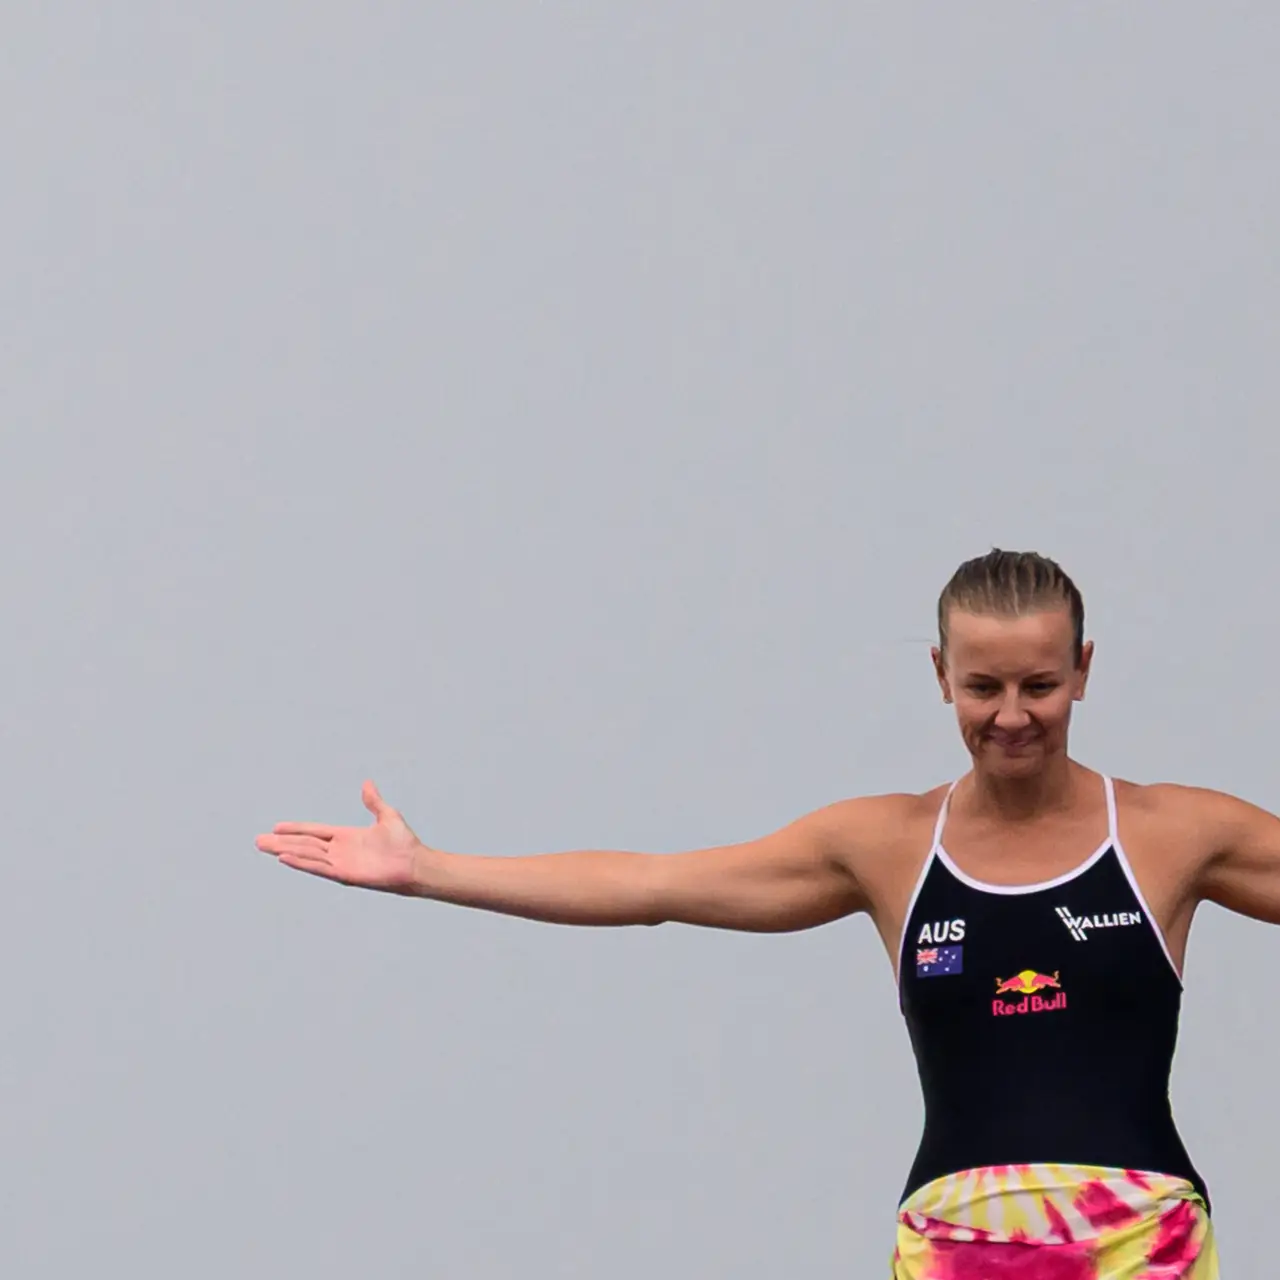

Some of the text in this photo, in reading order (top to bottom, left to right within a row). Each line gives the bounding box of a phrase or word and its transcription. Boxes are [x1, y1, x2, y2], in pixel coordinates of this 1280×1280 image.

[918, 919, 966, 943] AUS
[1055, 907, 1141, 941] WALLIEN
[992, 992, 1067, 1016] Red Bull
